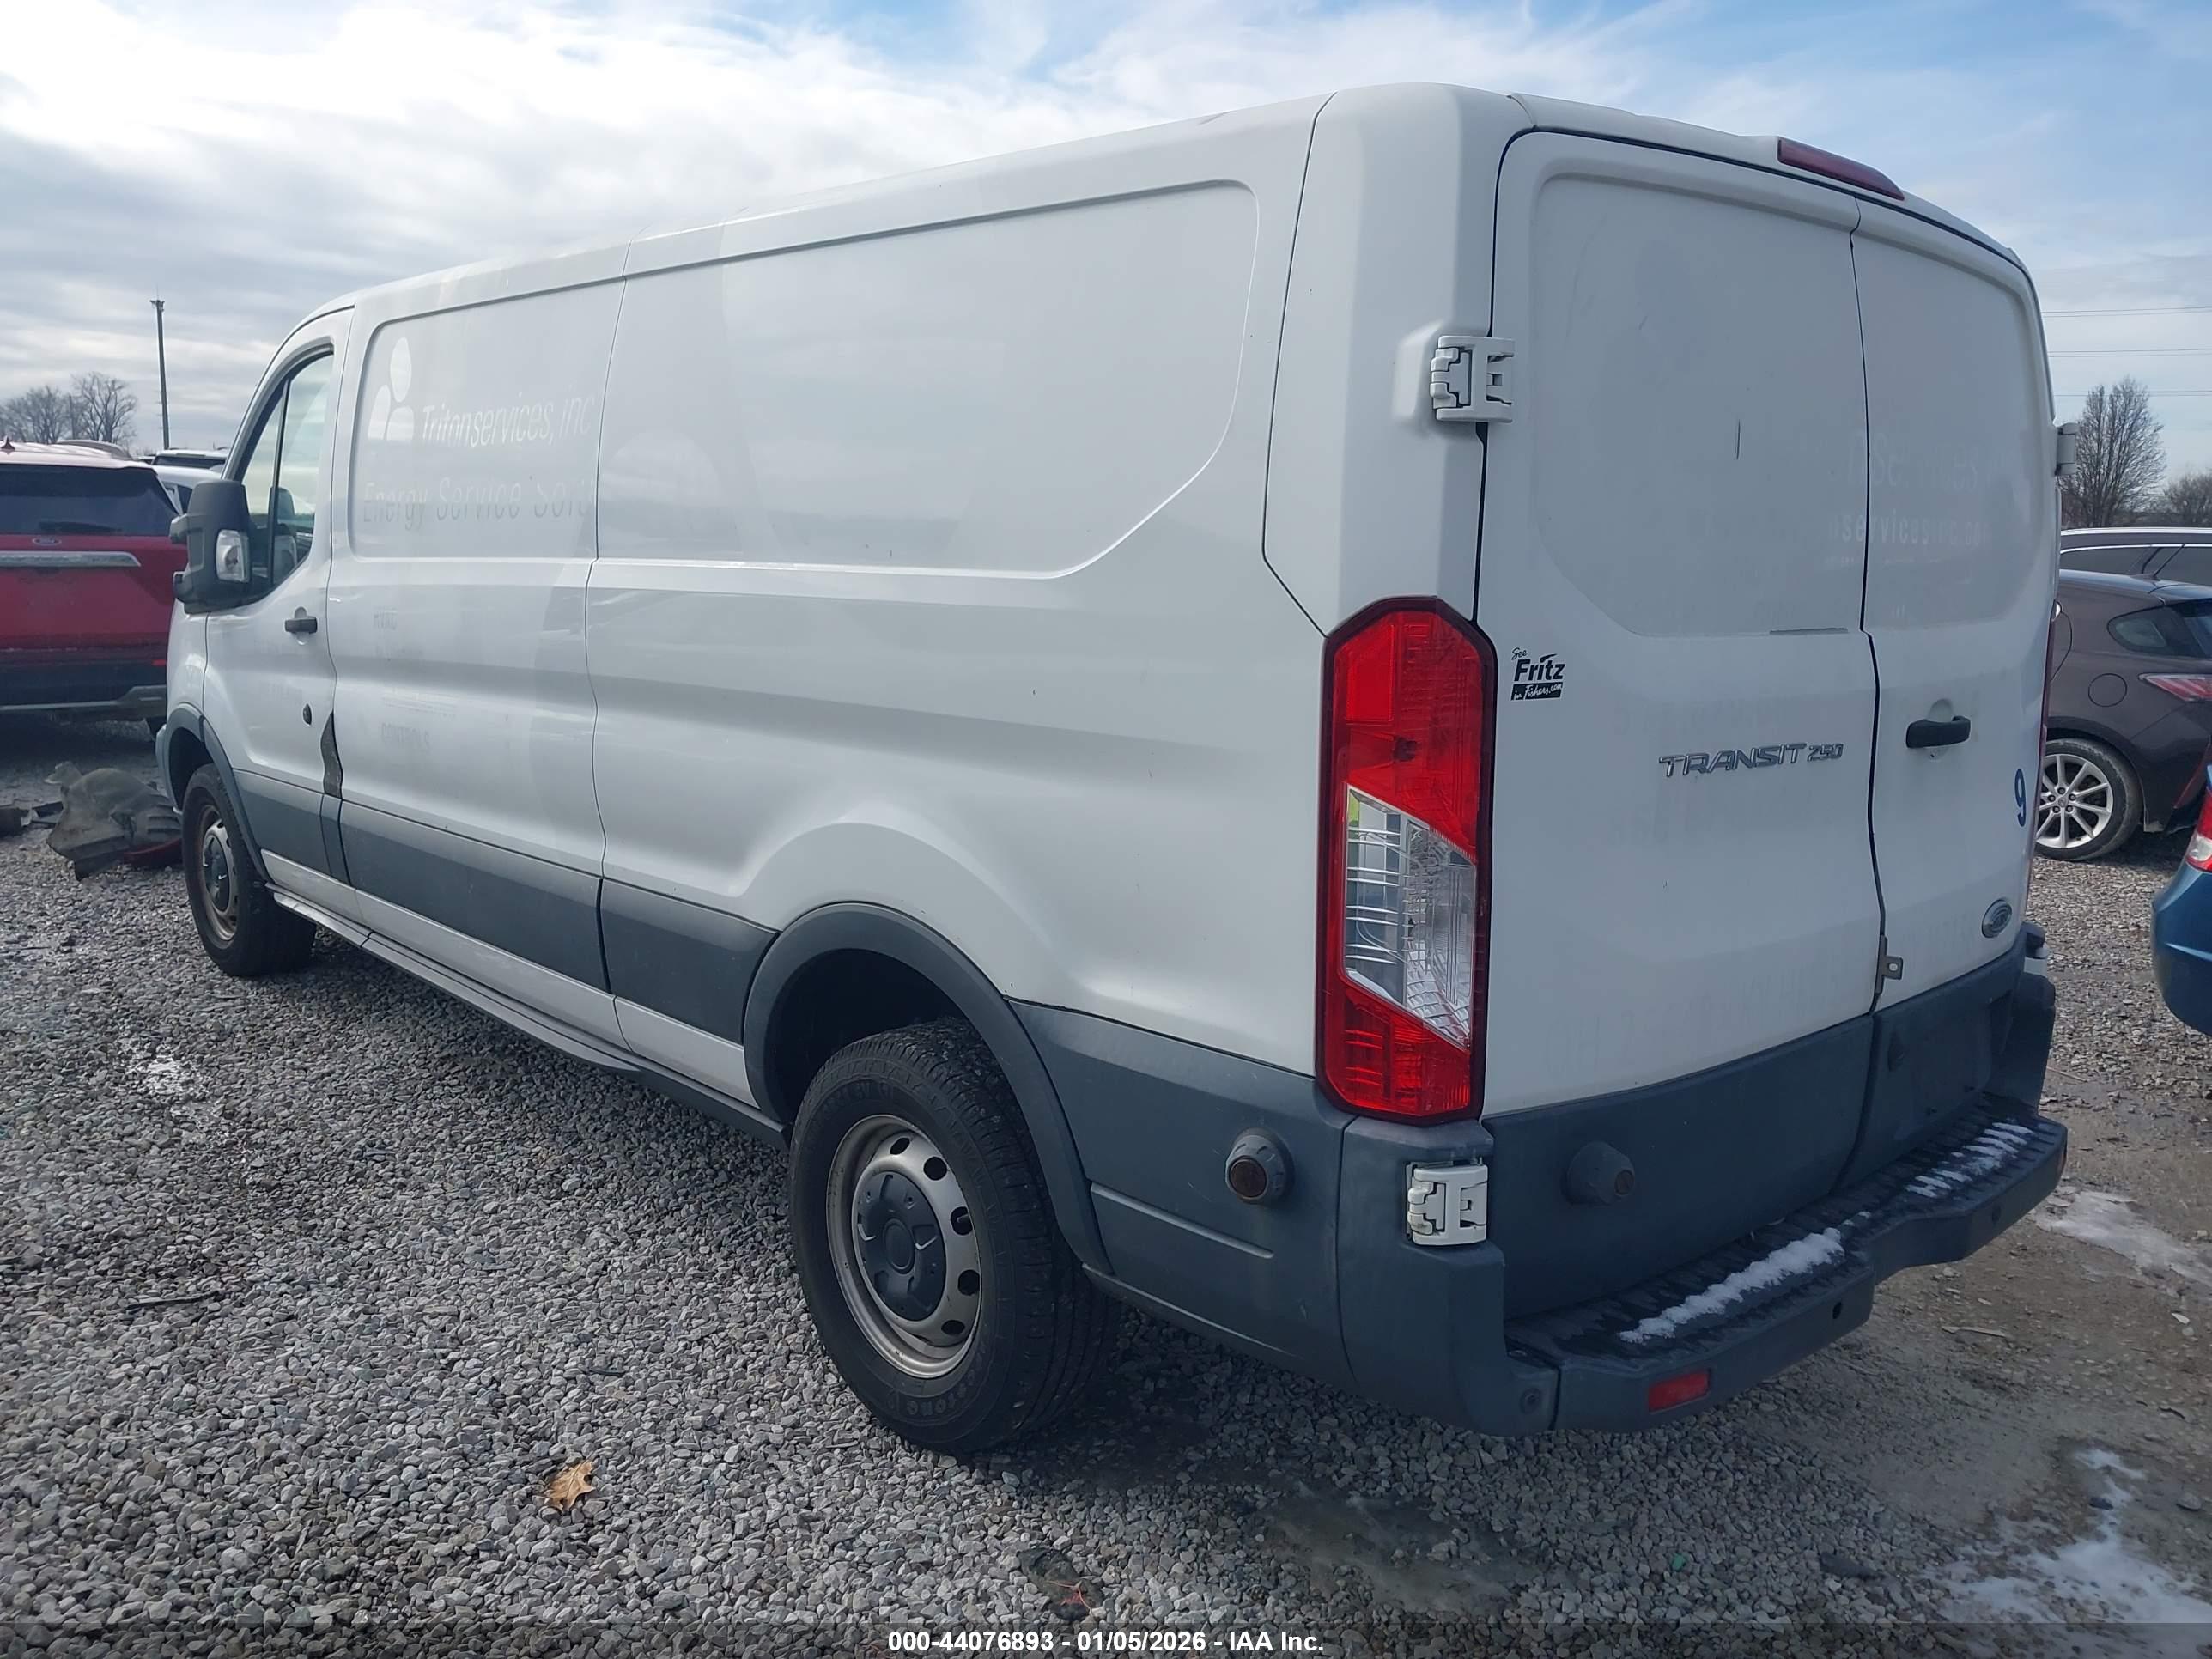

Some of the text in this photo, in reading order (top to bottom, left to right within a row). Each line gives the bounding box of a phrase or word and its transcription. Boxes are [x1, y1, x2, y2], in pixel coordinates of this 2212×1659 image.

[437, 477, 521, 521] Service
[1511, 647, 1527, 660] See
[1514, 653, 1565, 681] Fritz
[1659, 743, 1844, 777] TRANSIT 250
[2014, 769, 2027, 827] 9
